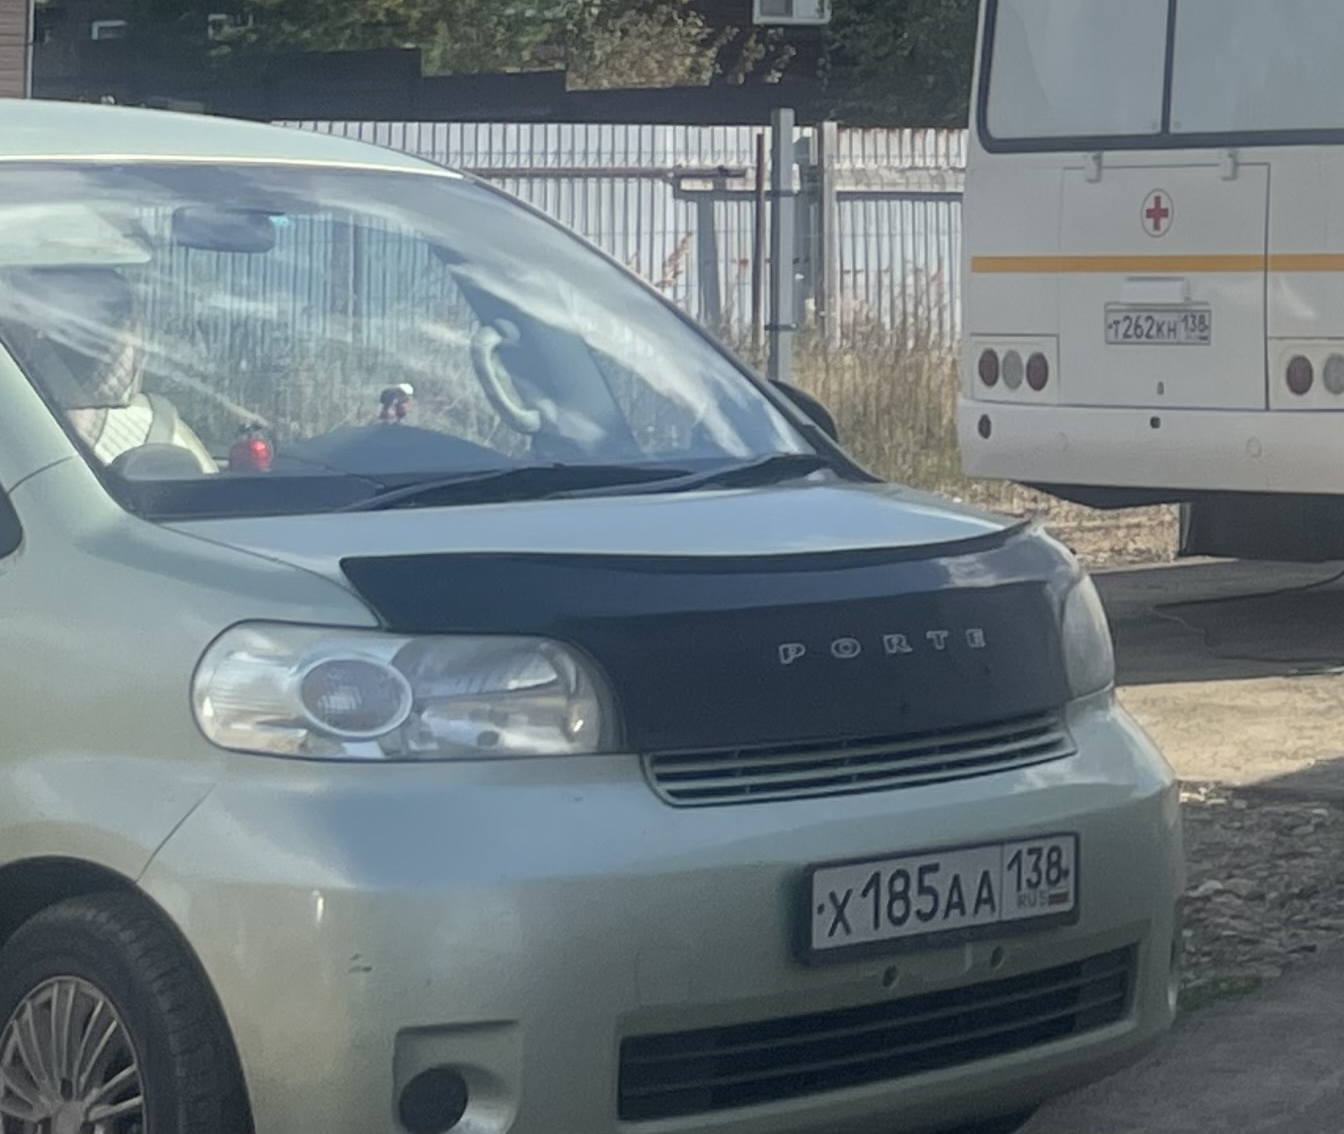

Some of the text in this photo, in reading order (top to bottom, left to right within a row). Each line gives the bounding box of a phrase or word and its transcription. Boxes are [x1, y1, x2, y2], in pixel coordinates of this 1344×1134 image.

[1181, 313, 1206, 333] 138
[778, 628, 986, 665] PORTE
[827, 845, 1064, 938] Х185АА 138
[1016, 890, 1048, 909] RUS
